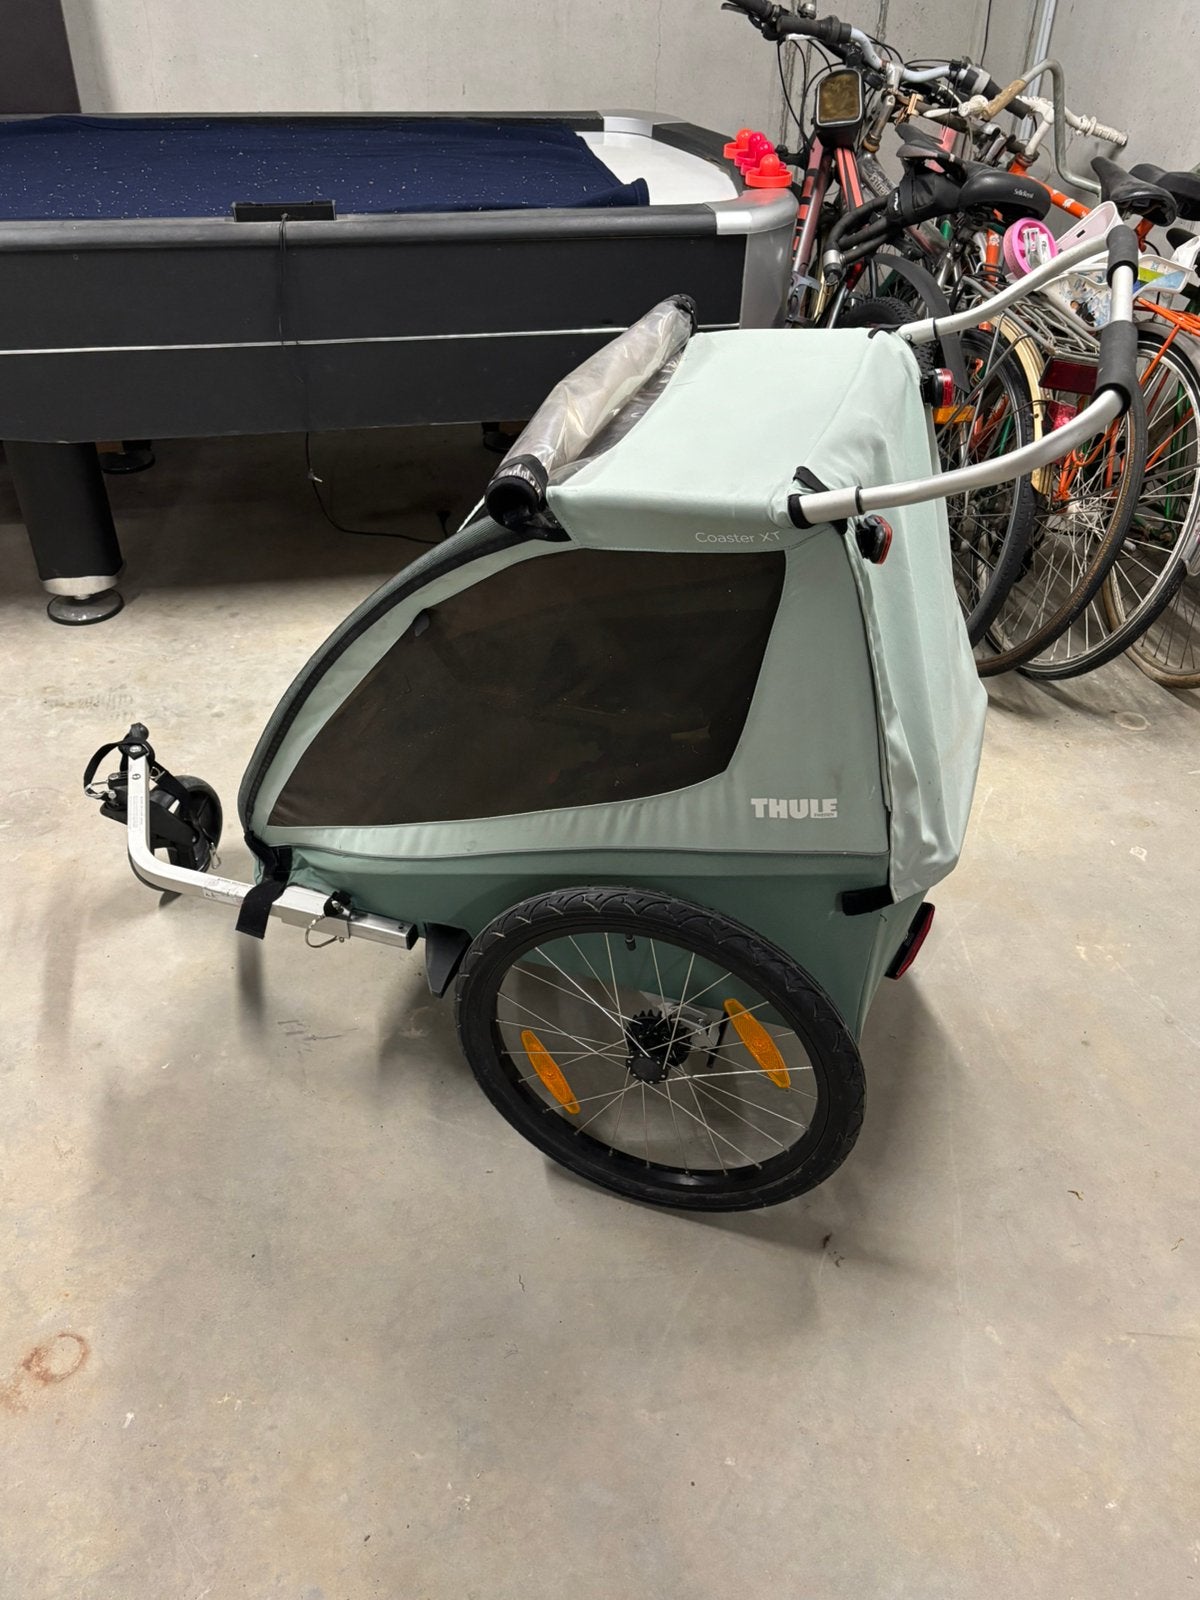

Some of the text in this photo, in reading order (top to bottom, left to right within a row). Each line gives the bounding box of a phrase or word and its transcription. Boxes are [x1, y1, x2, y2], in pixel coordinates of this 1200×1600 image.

[695, 531, 780, 543] Coaster XT
[750, 798, 838, 819] THULE
